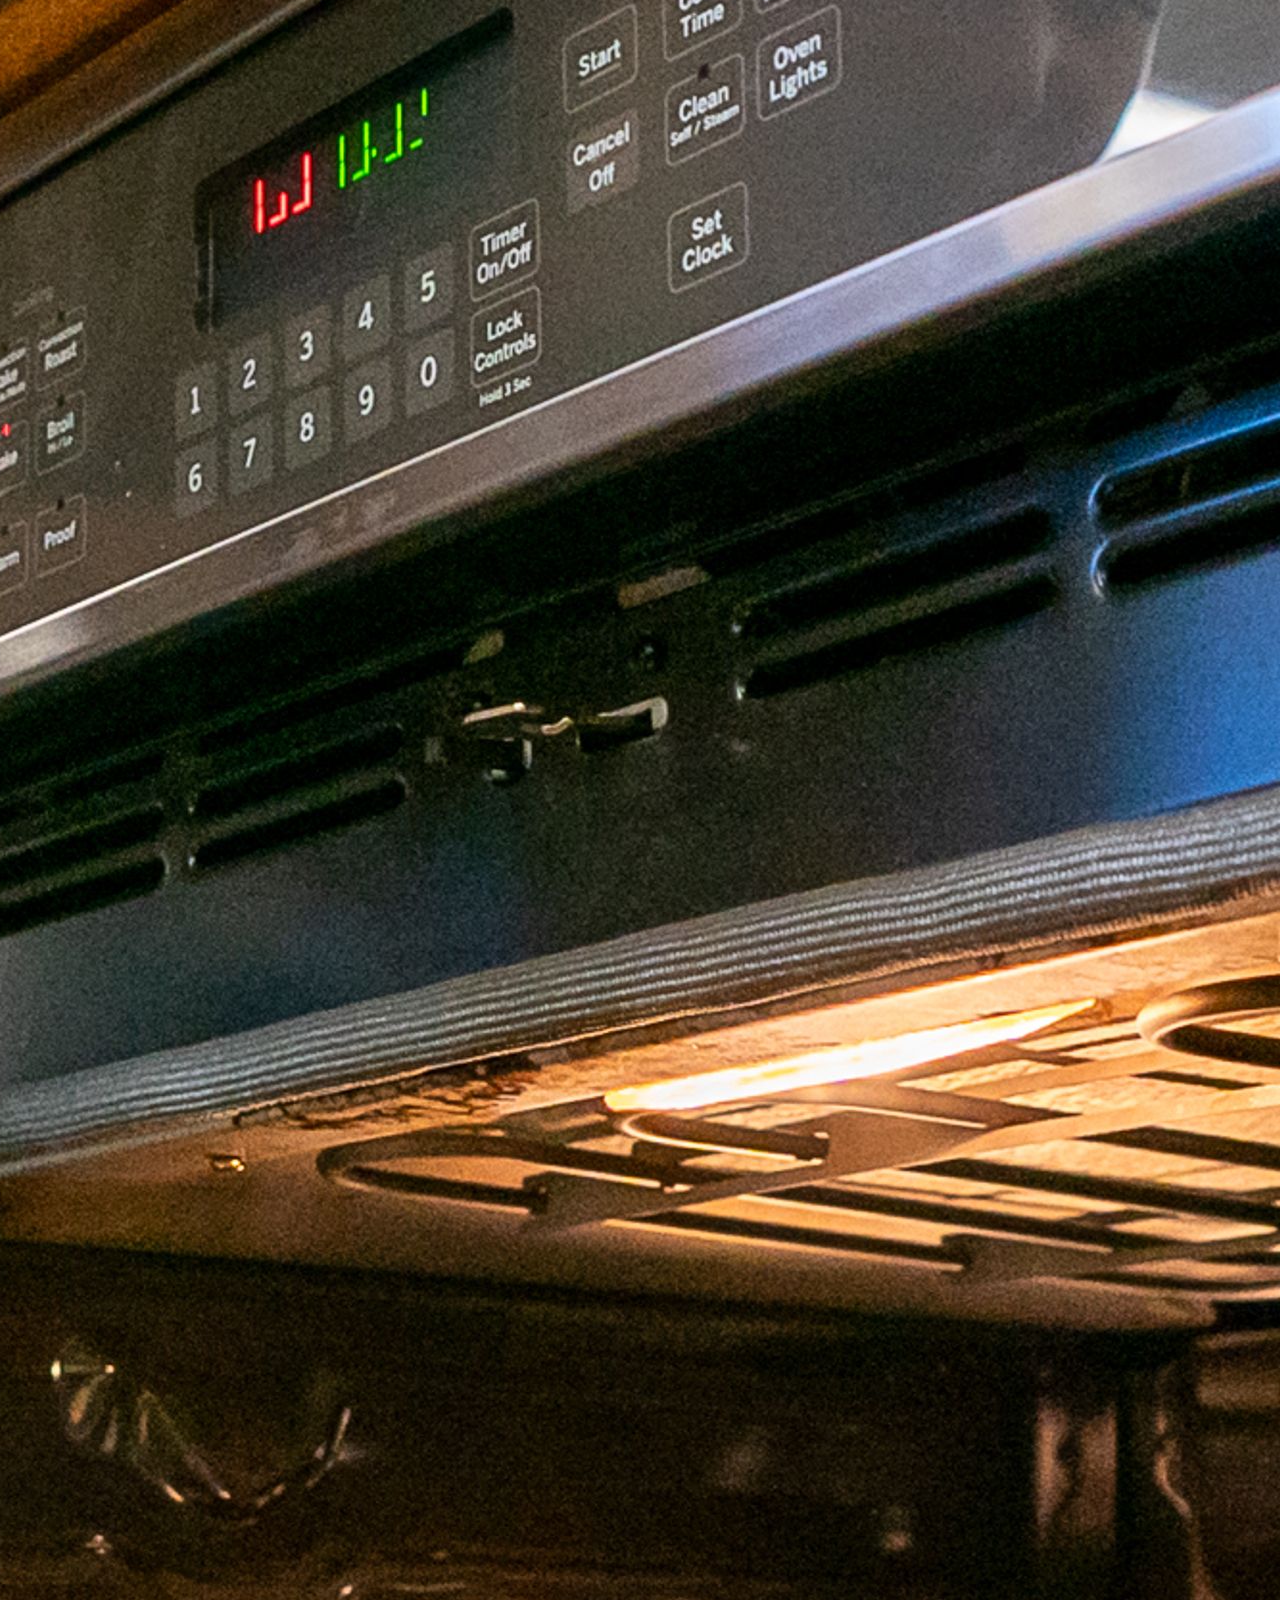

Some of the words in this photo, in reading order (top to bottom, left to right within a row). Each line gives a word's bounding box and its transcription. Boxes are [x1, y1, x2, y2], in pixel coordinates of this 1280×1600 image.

[680, 3, 724, 38] Time
[578, 39, 621, 77] Start
[773, 34, 821, 70] Oven
[769, 59, 827, 102] Lights
[678, 85, 729, 122] Clean
[573, 121, 630, 166] Cancel
[589, 162, 615, 191] Off
[480, 222, 527, 256] Timer
[691, 210, 722, 240] Set
[476, 240, 531, 284] On/Off
[682, 234, 733, 272] Clock
[190, 386, 201, 414] 1
[242, 359, 256, 389] 2
[299, 331, 314, 361] 3
[358, 301, 374, 330] 4
[420, 271, 436, 302] 5
[487, 310, 523, 341] Lock
[45, 341, 77, 370] Roast
[474, 332, 536, 373] Controls
[479, 388, 501, 407] Hold
[504, 381, 512, 396] 3
[512, 375, 532, 392] Sec
[189, 463, 202, 492] 6
[243, 438, 256, 468] 7
[299, 412, 315, 442] 8
[358, 384, 374, 415] 9
[420, 356, 437, 387] 0
[44, 520, 76, 550] Proof
